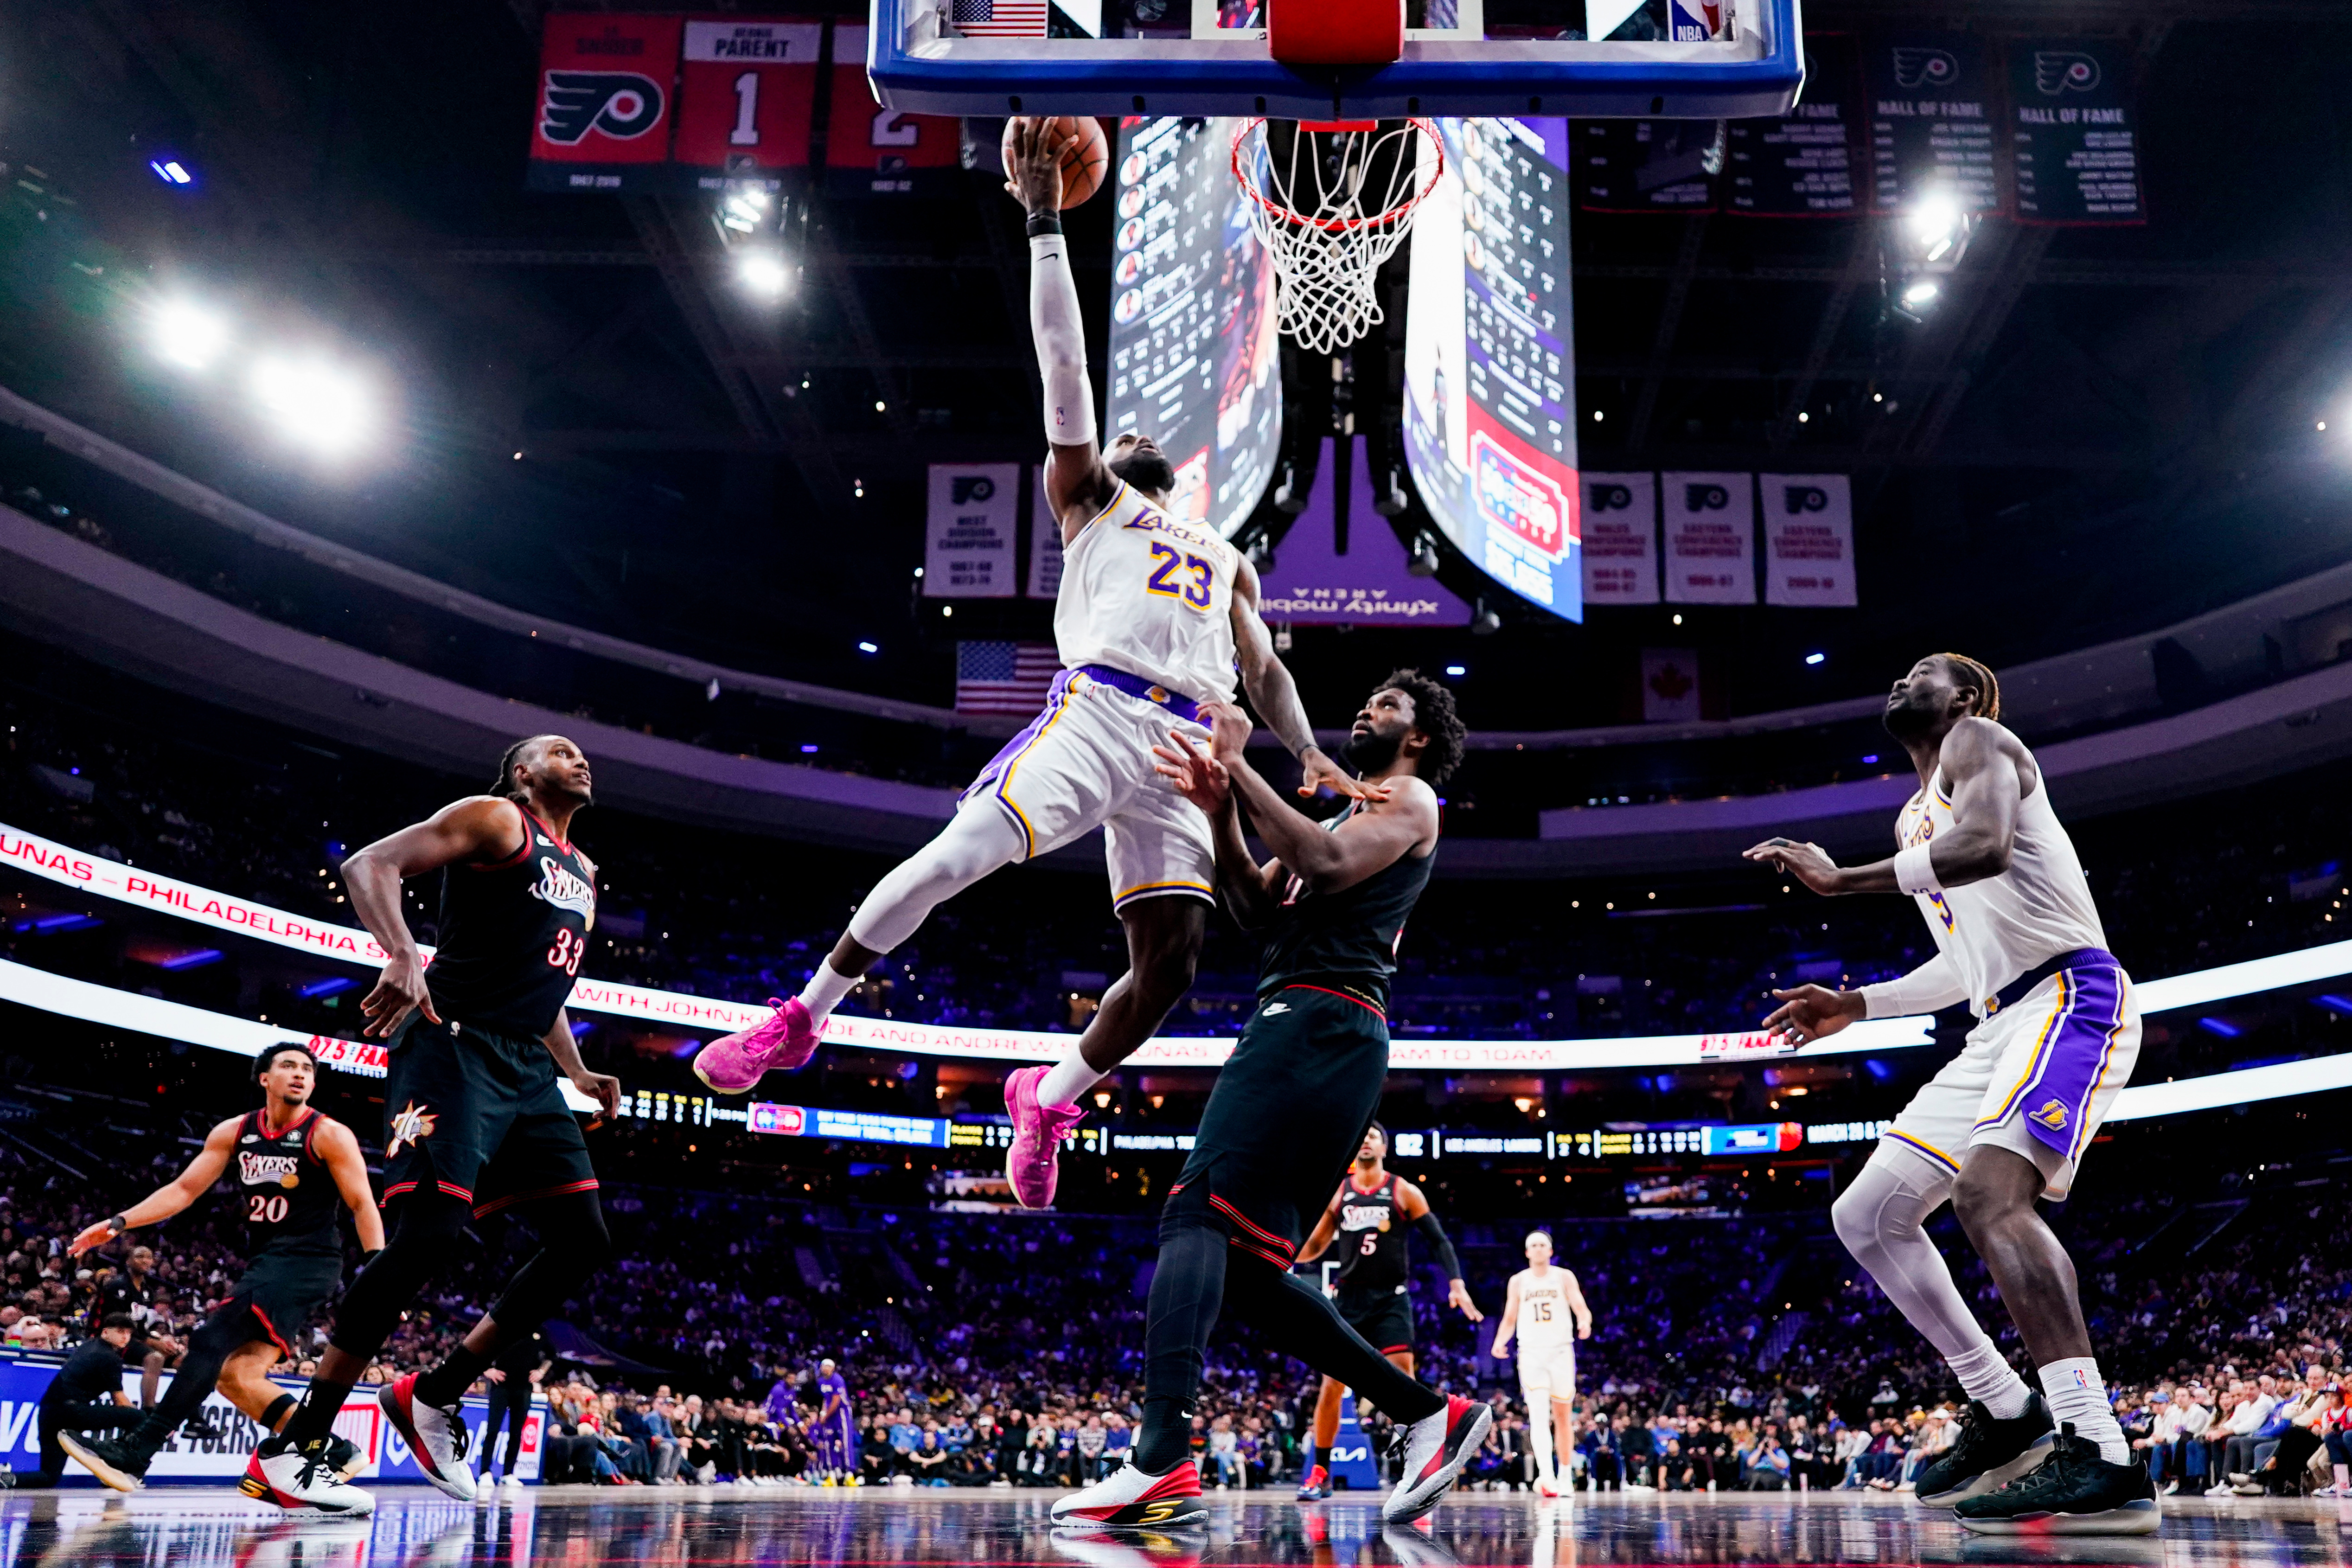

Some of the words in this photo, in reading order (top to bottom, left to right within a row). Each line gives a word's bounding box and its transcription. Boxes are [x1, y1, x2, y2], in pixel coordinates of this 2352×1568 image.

[1677, 25, 1703, 41] NBA
[716, 38, 789, 58] PARENT
[731, 72, 759, 146] 1
[1877, 101, 1915, 116] HALL
[2019, 107, 2058, 124] HALL
[2082, 108, 2125, 124] FAME
[1123, 504, 1226, 562] LAKERS
[1147, 540, 1213, 611] 23
[126, 877, 355, 954] PHILADELPHIA
[547, 928, 585, 976] 33
[575, 986, 648, 1009] WITH
[656, 1001, 733, 1022] JOHN
[870, 1027, 927, 1044] AND
[935, 1035, 1052, 1052] ANDREW
[1439, 1049, 1470, 1060] TO
[1807, 1123, 1847, 1144] MARCH
[1864, 1120, 1875, 1140] &
[249, 1195, 289, 1223] 20
[1360, 1233, 1378, 1255] 5
[1534, 1302, 1552, 1323] 15
